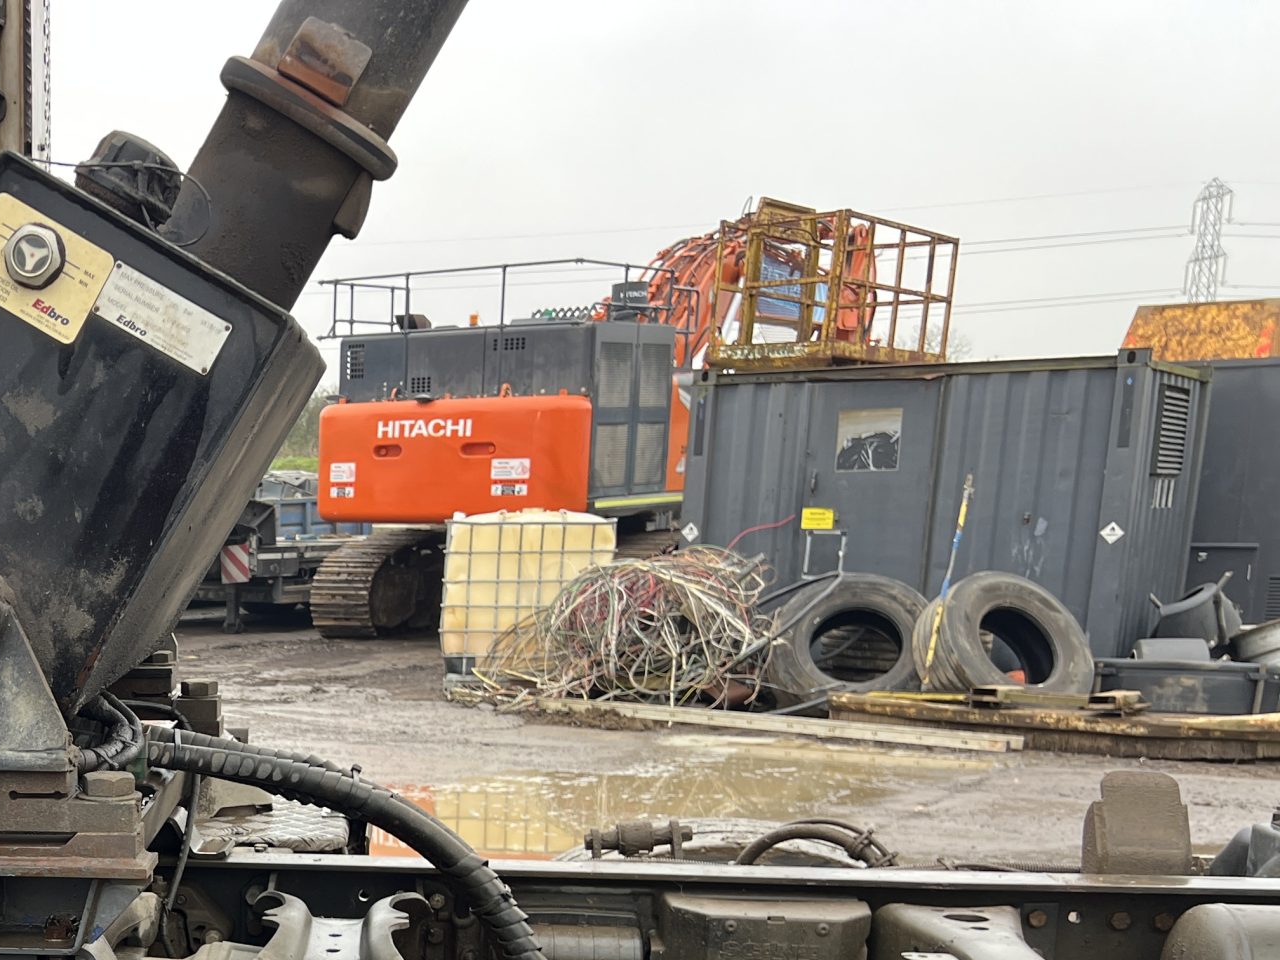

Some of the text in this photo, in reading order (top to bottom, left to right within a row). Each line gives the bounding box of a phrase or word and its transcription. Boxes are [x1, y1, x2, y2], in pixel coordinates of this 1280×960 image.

[78, 279, 89, 288] MIN
[84, 270, 95, 280] MAX
[32, 298, 70, 326] Edbro
[116, 314, 147, 337] Edbro
[376, 418, 473, 439] HITACHI
